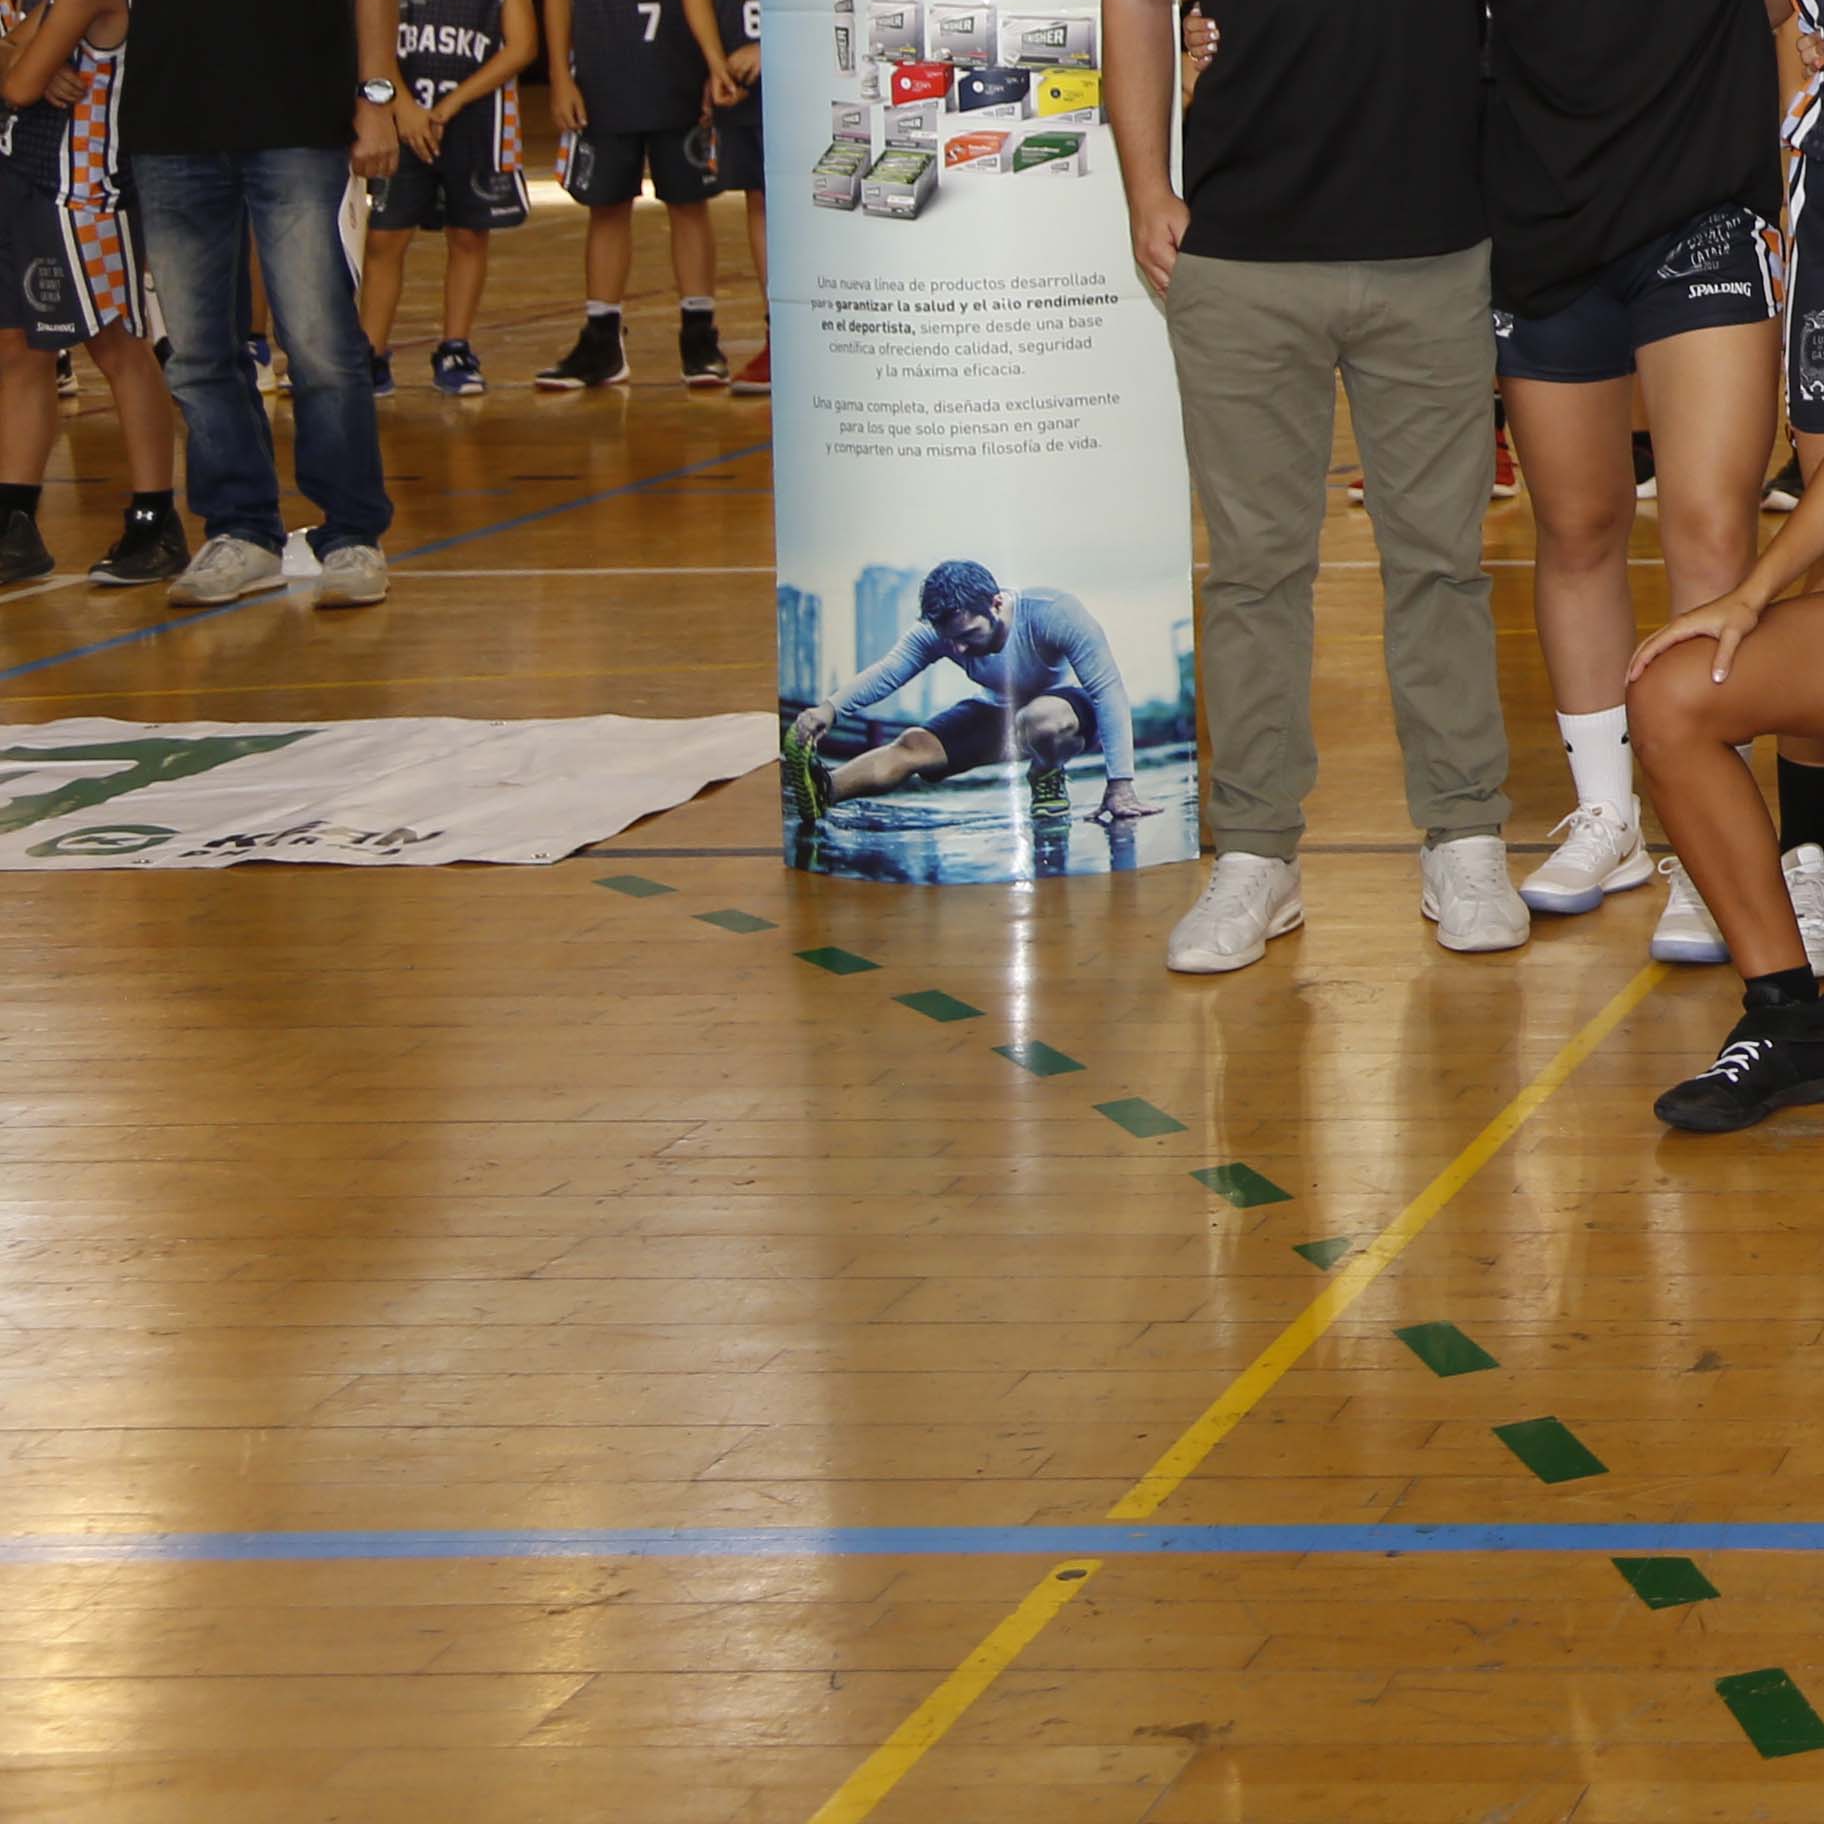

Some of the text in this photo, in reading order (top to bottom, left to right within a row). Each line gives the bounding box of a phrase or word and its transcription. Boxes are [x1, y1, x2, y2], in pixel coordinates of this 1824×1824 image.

[637, 2, 662, 41] 7
[840, 273, 1106, 295] nueva línea de productos desarrollada
[1688, 282, 1751, 299] SPALDING
[836, 293, 1118, 315] garantizar la salud y el rendimiento
[821, 315, 1103, 337] en el deportista, siempre desde una base
[879, 336, 1092, 357] ofreciendo calidad, seguridad
[886, 363, 1024, 377] la máxima eficacia.
[867, 392, 1120, 418] completa, diseñada exclusivamente
[839, 417, 1080, 438] para los que solo piensan en ganar
[834, 439, 1064, 460] comparten una misma filosofía de
